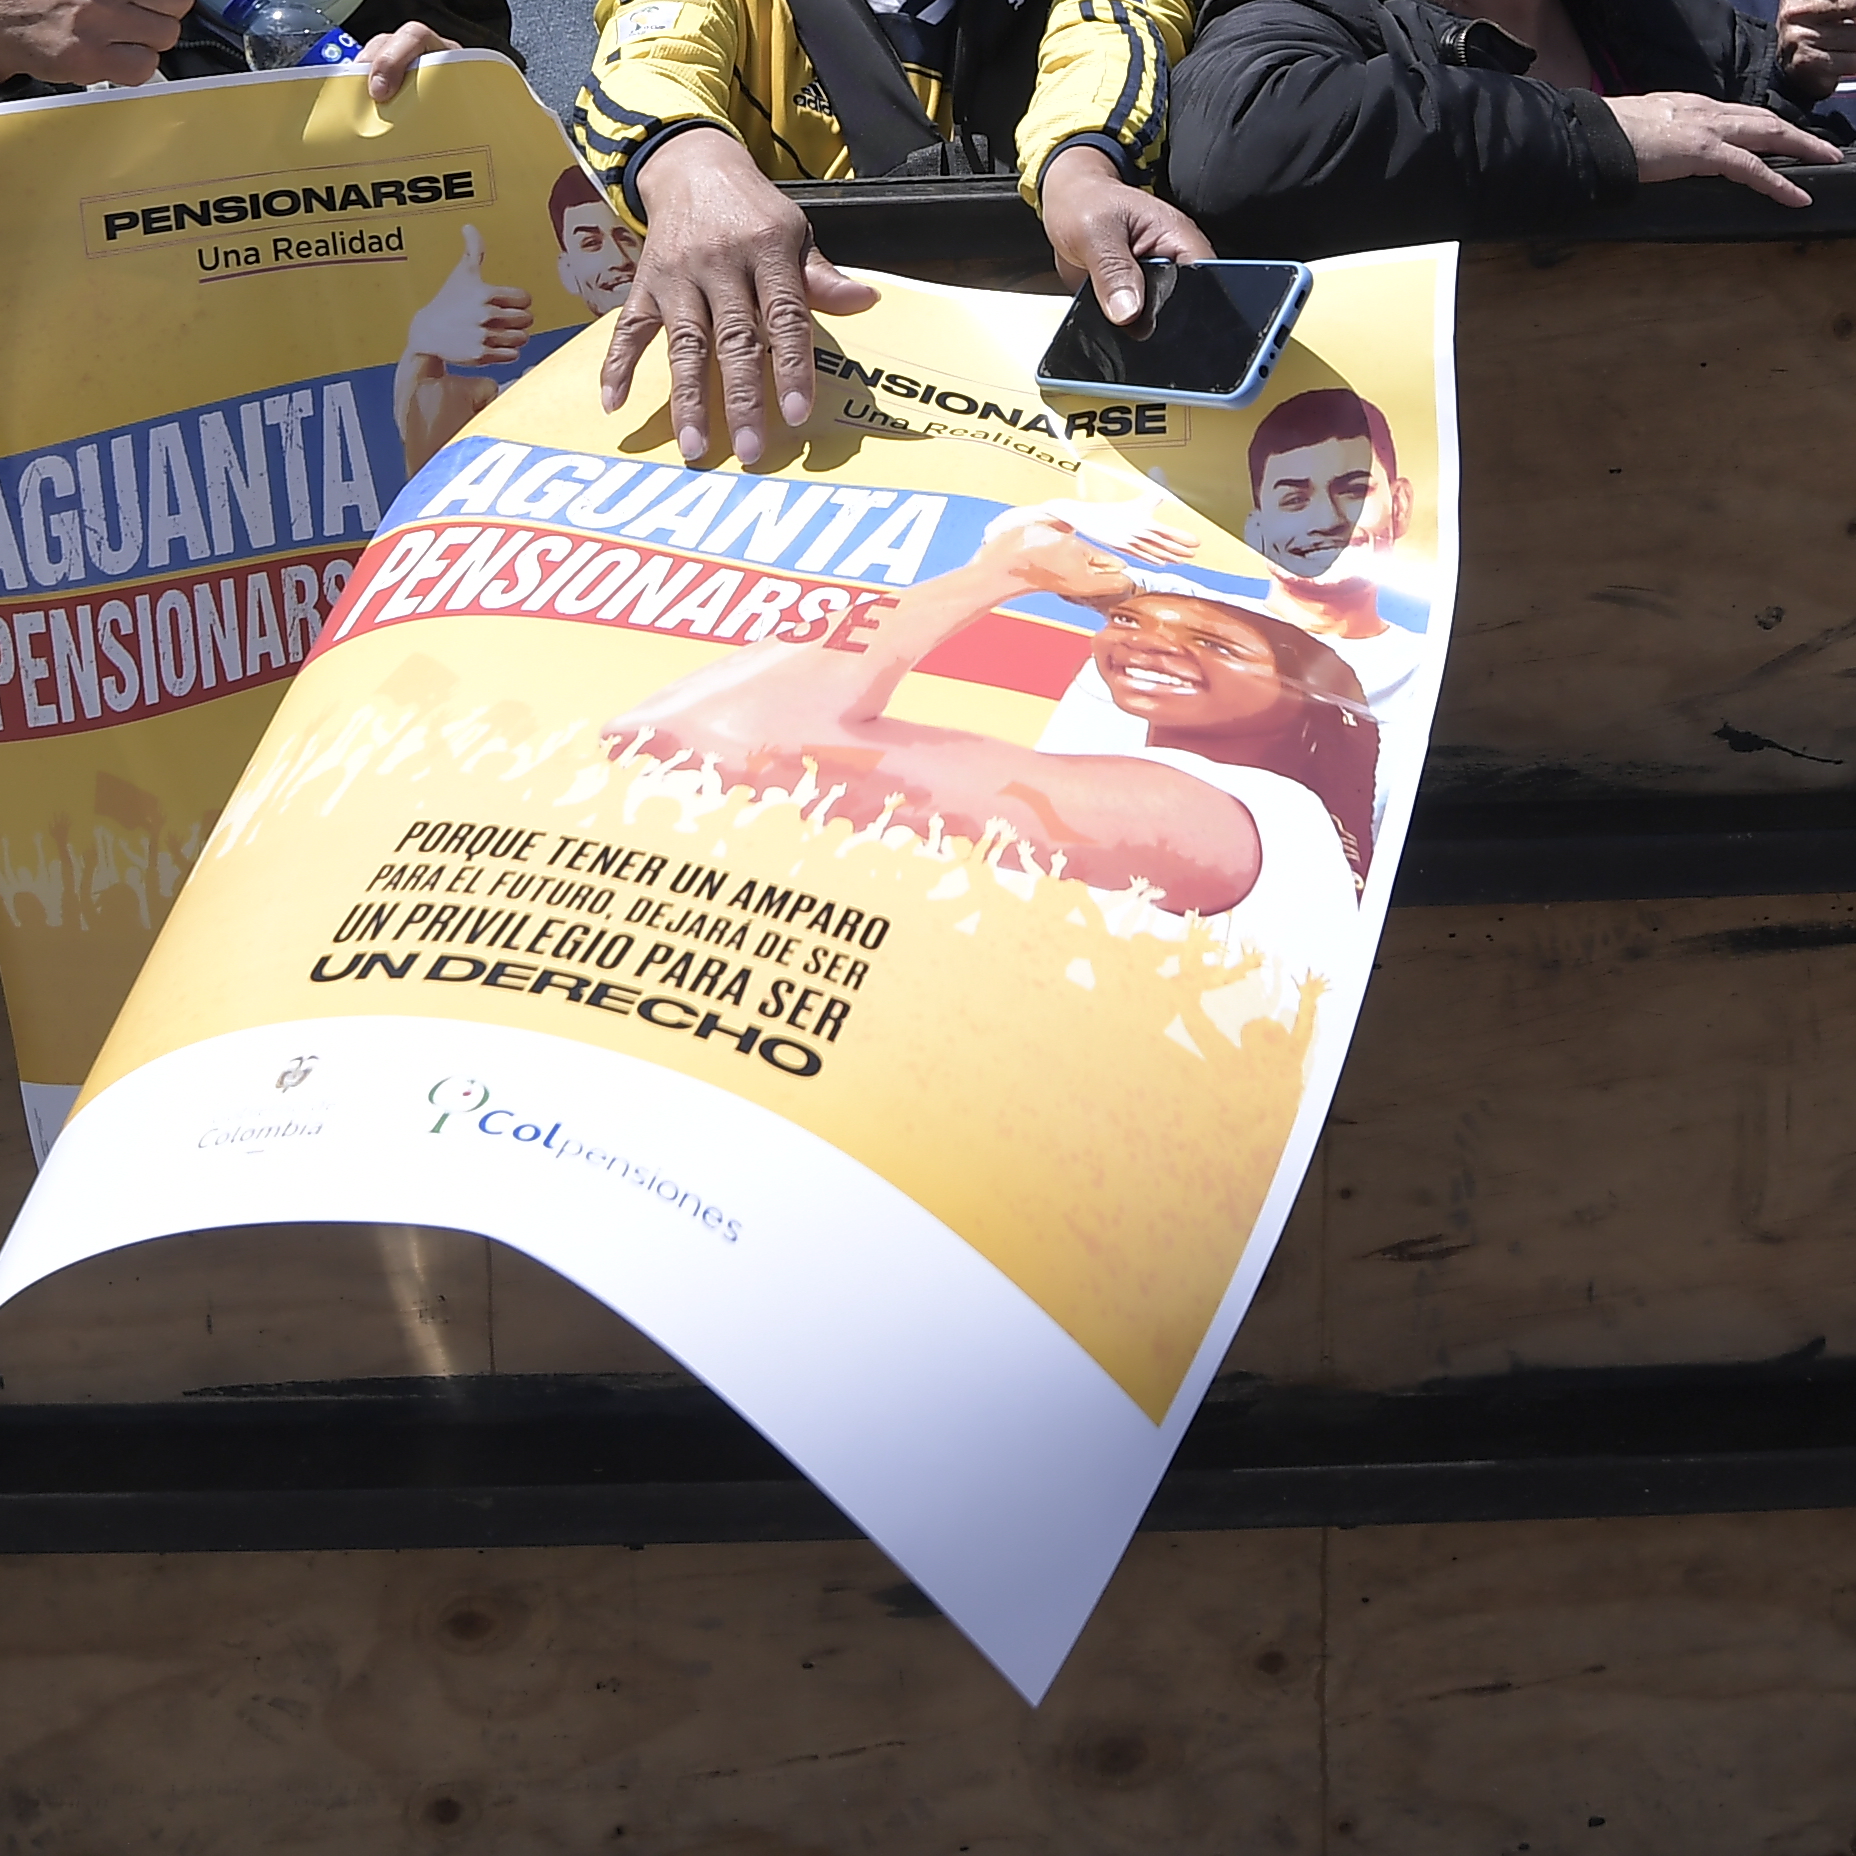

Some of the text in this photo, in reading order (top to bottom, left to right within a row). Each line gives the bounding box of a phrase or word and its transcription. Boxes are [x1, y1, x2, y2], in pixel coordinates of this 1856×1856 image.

[793, 93, 834, 118] adid
[103, 170, 476, 242] PENSIONARSE
[197, 226, 405, 272] Una Realidad
[814, 347, 1167, 441] ENSIONARSE
[843, 398, 1082, 473] Una Realidad
[417, 441, 949, 585] AGUANTA
[332, 525, 900, 654] PENSIONARSE
[365, 863, 870, 992] PARA EL FUTURO, DEJARÁ DE SER
[394, 821, 891, 950] PORQUE TENER UN AMPARO
[309, 951, 823, 1078] UN DERECHO
[333, 902, 852, 1044] UN PRIVILEGIO PARA SER
[198, 1119, 325, 1150] Colombia
[477, 1109, 742, 1244] Colpensiones
